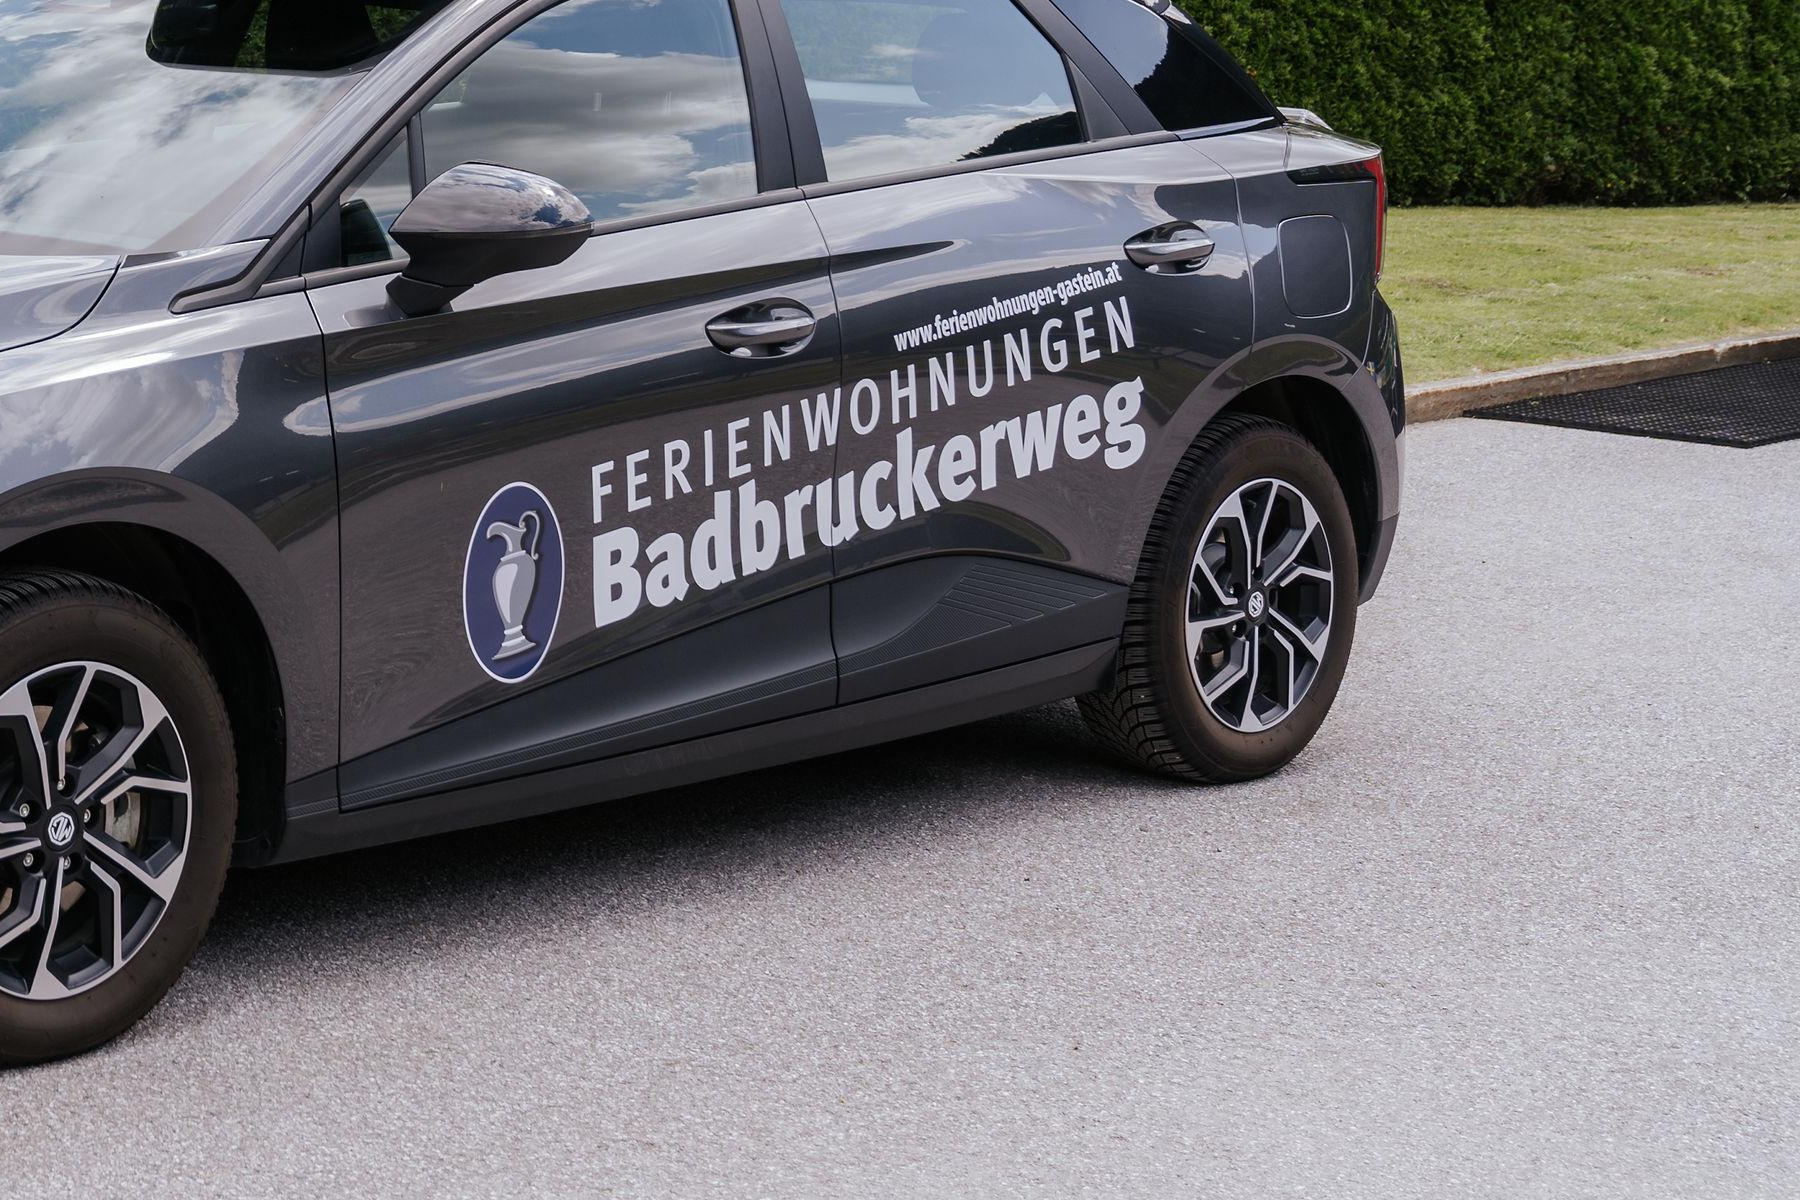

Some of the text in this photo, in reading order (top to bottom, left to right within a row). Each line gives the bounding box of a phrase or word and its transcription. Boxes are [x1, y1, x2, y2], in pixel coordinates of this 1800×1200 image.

[591, 296, 1136, 524] FERIENWOHNUNGEN
[893, 261, 1122, 352] www.ferienwohnungen-gastein.at
[591, 376, 1147, 629] Badbruckerweg
